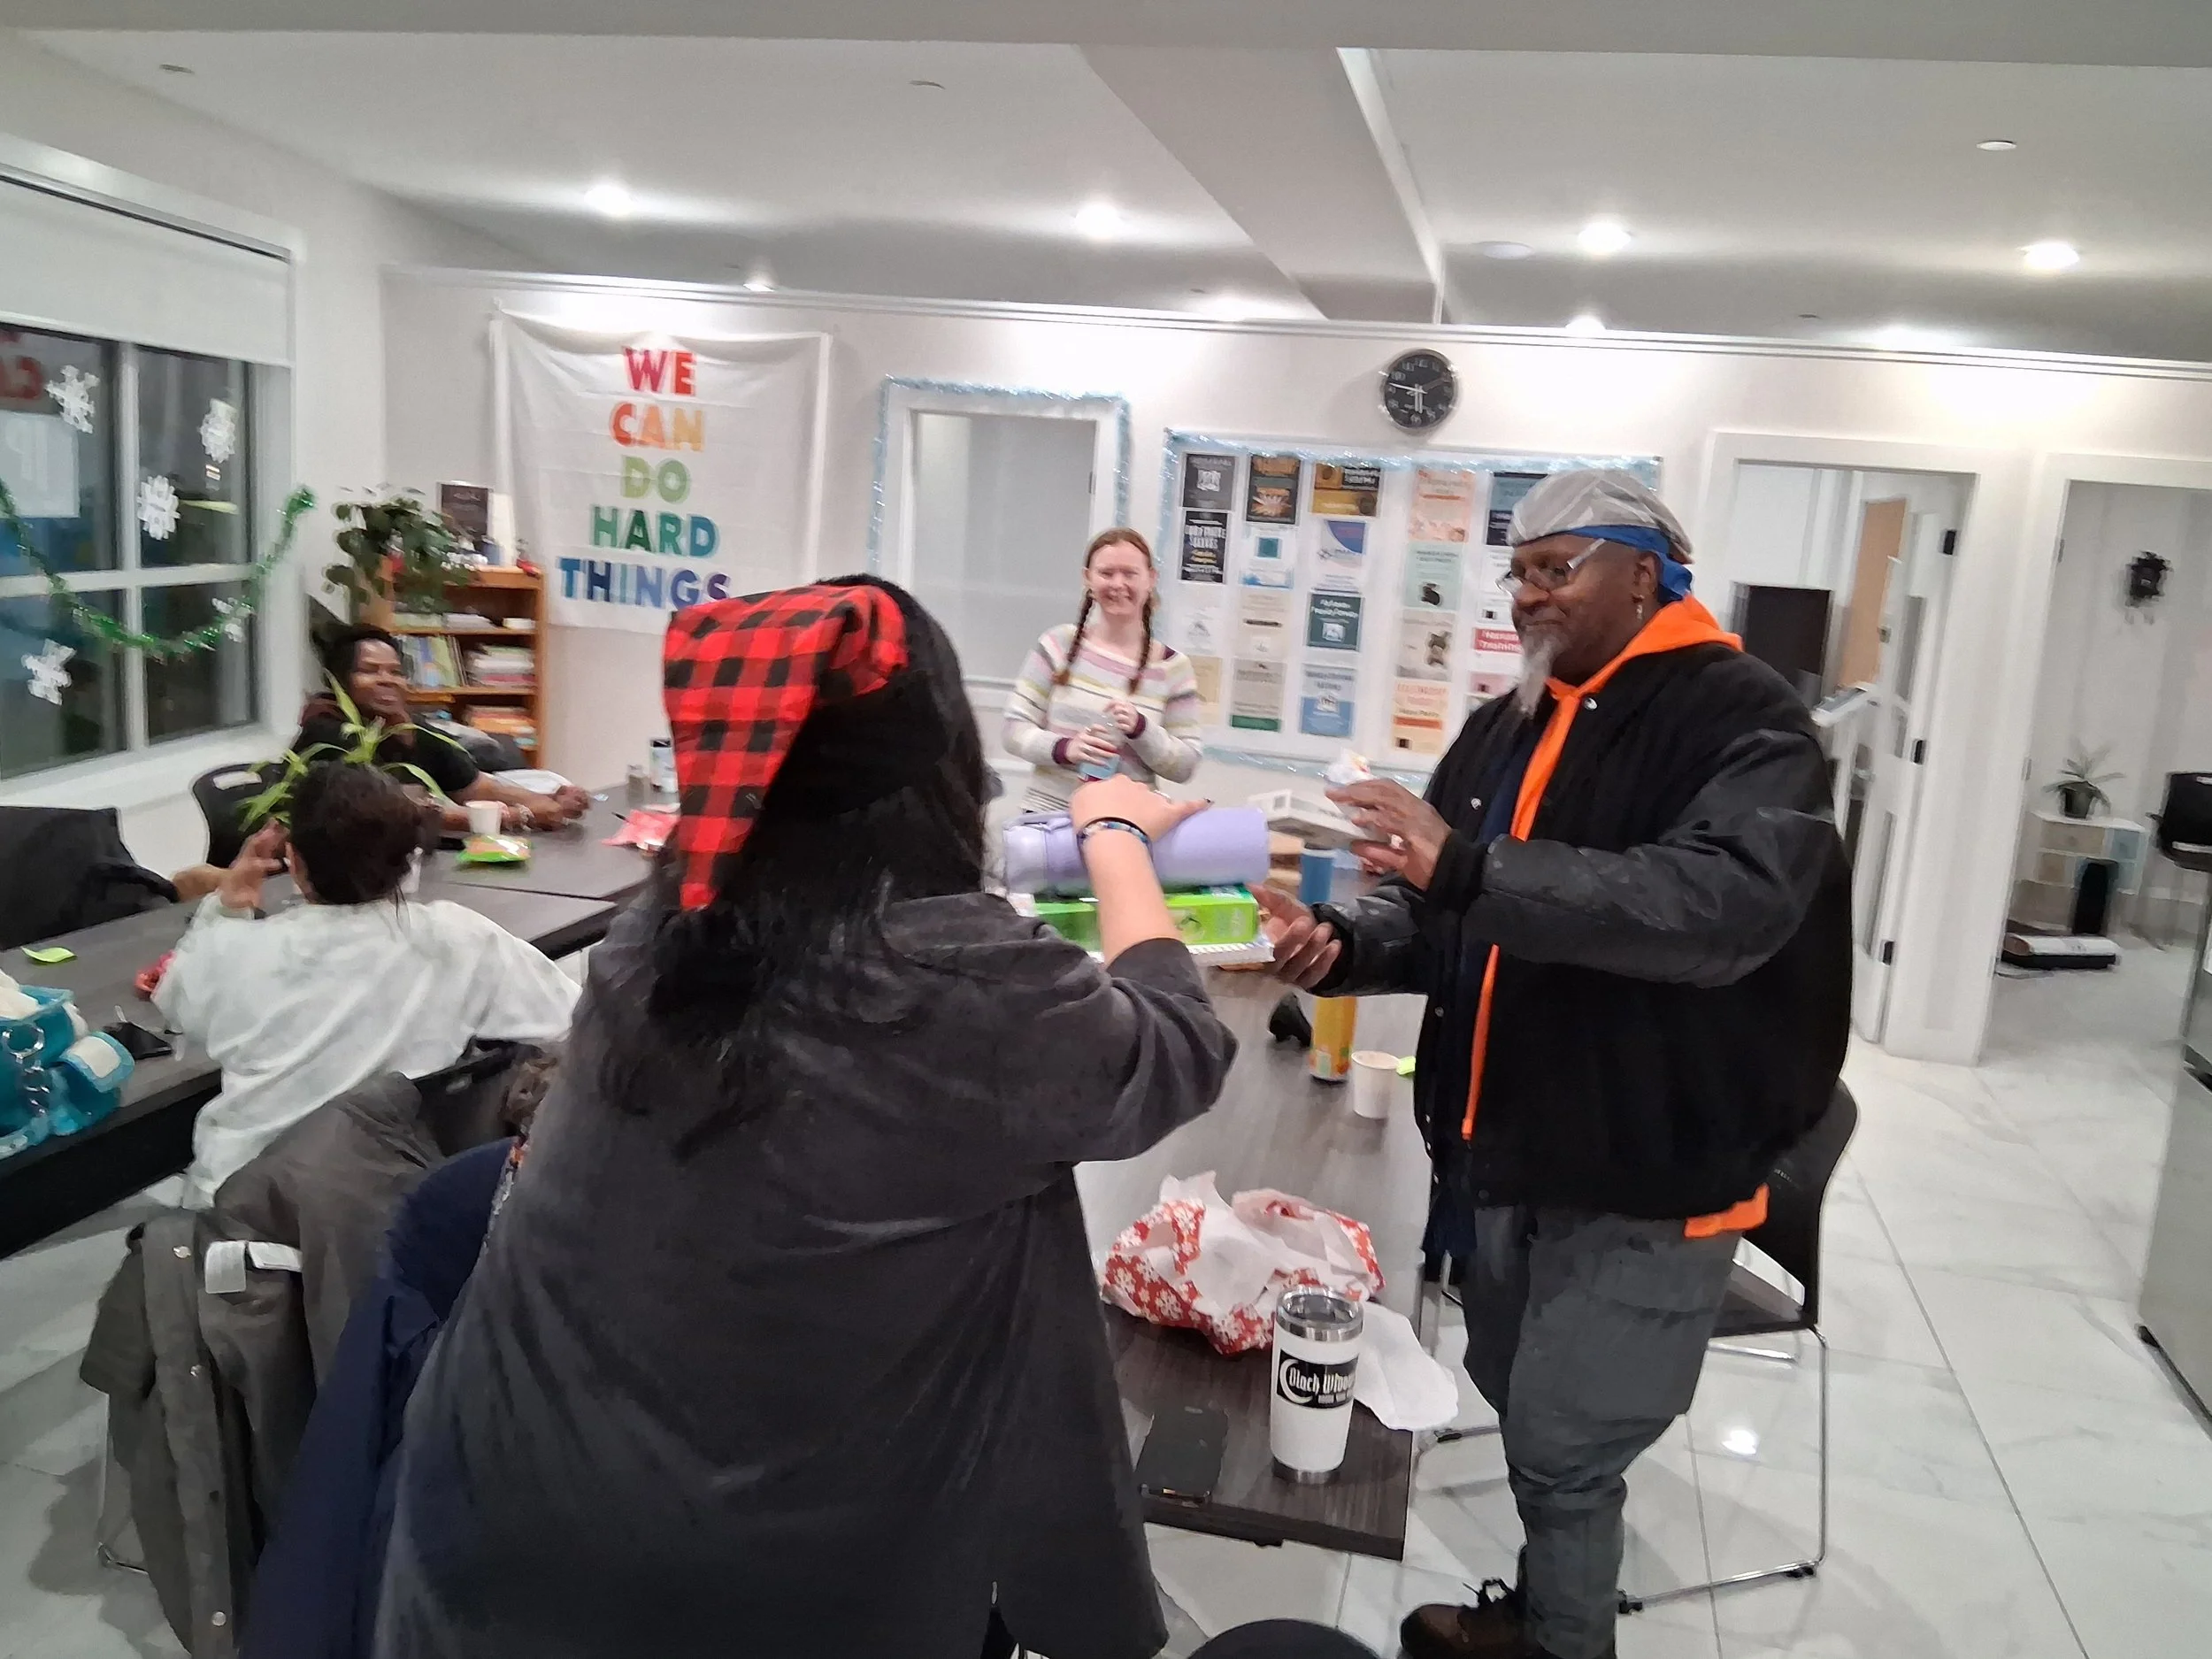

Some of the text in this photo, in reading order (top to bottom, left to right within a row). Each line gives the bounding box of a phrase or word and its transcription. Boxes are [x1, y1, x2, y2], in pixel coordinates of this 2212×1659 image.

[625, 347, 695, 396] WE
[611, 403, 703, 450] CAN
[623, 456, 690, 503] DO
[592, 505, 719, 557] HARD
[558, 557, 731, 609] THINGS
